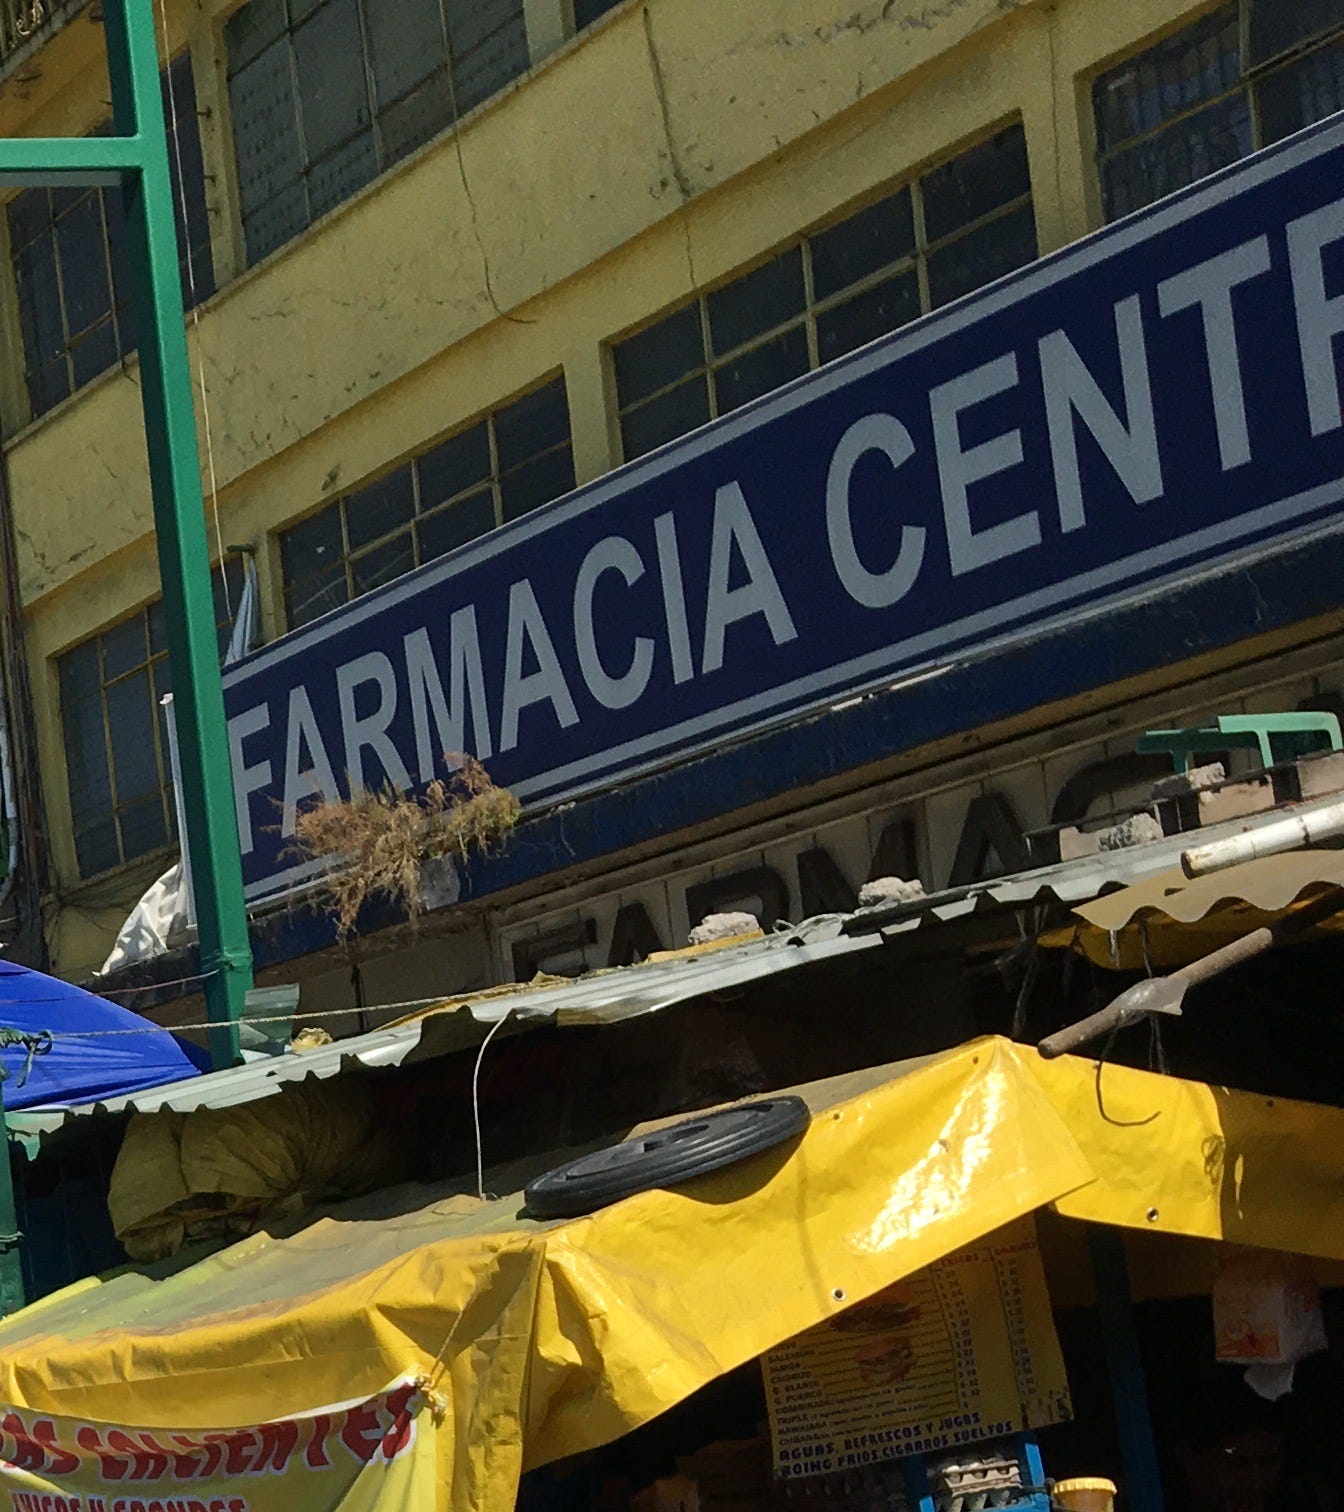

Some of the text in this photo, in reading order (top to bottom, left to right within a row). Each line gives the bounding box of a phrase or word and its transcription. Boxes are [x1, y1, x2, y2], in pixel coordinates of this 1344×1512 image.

[226, 480, 799, 855] FARMACIA
[844, 1425, 922, 1451] REFRESCOS
[939, 1411, 981, 1432] JUGOS
[954, 1421, 1014, 1444] SUELTOS
